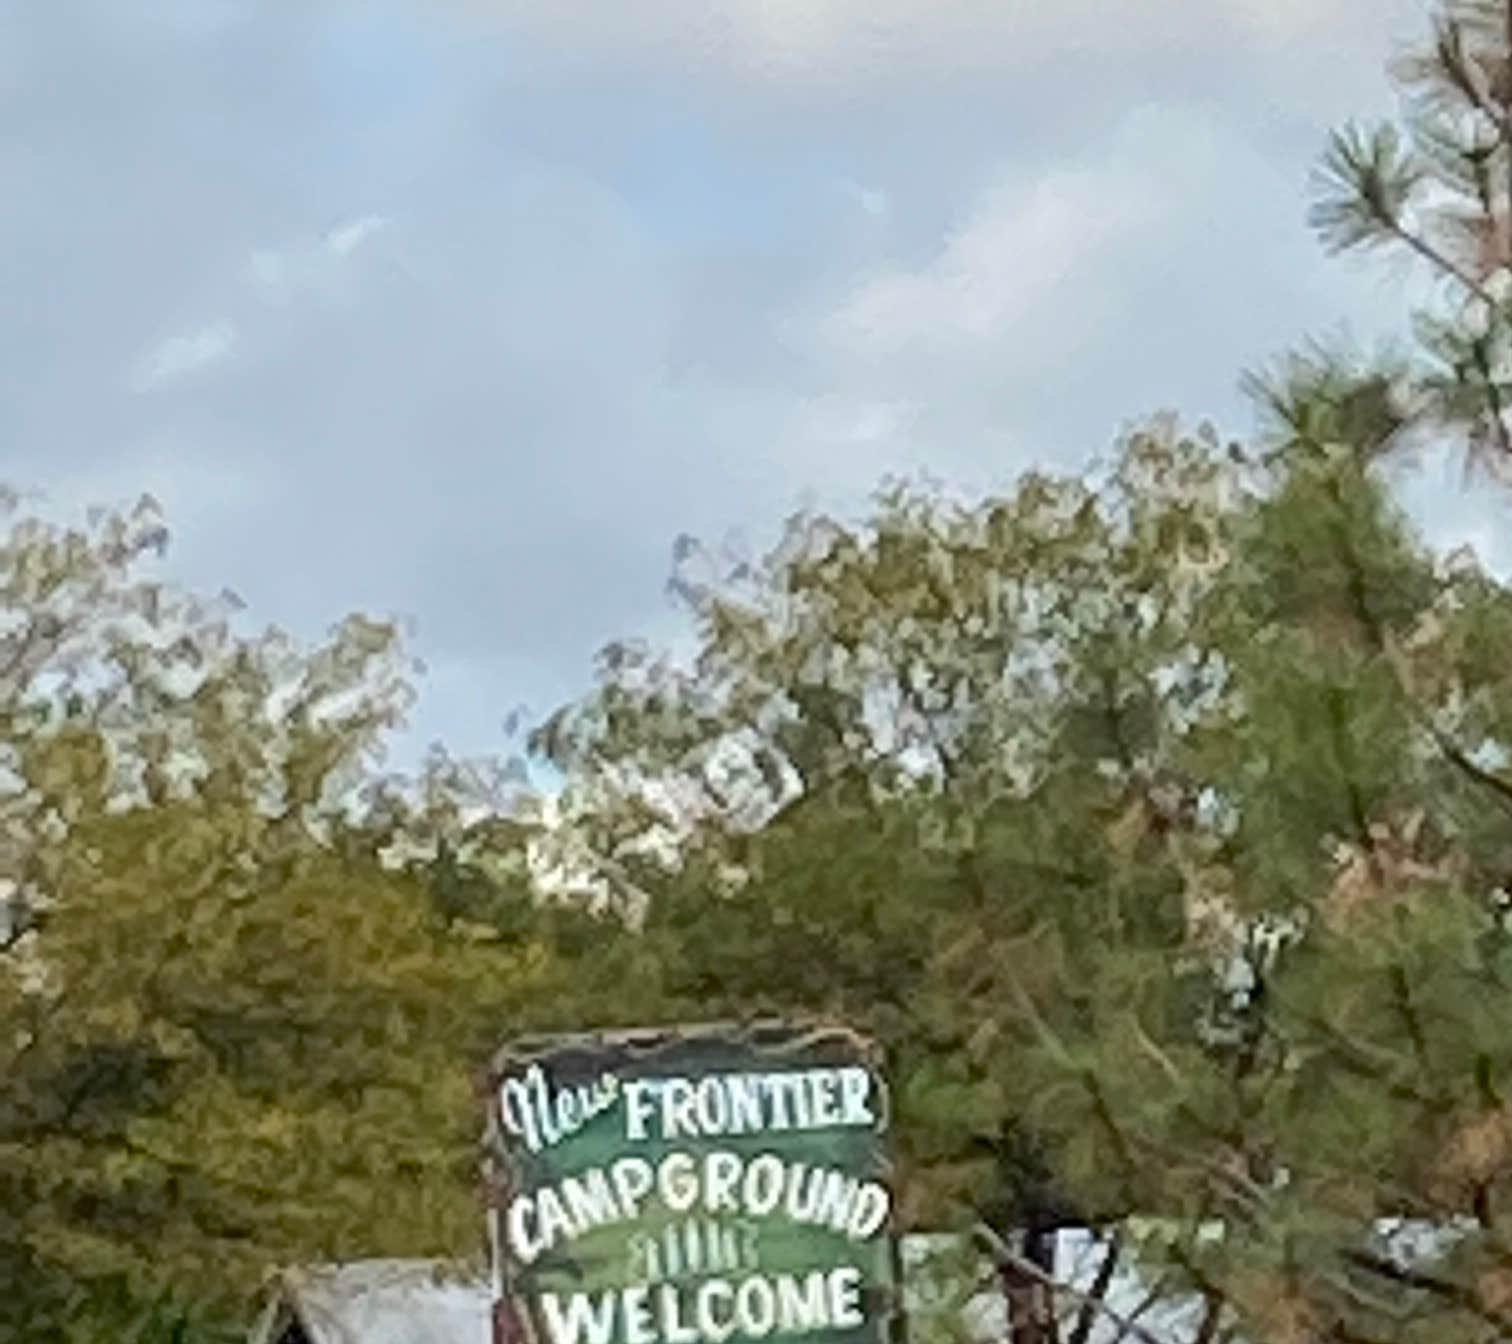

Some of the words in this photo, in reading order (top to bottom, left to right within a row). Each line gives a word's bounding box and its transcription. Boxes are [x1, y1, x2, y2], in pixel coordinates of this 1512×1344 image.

[501, 1063, 618, 1151] New
[624, 1068, 874, 1140] FRONTIER
[509, 1153, 890, 1262] CAMPGROUND
